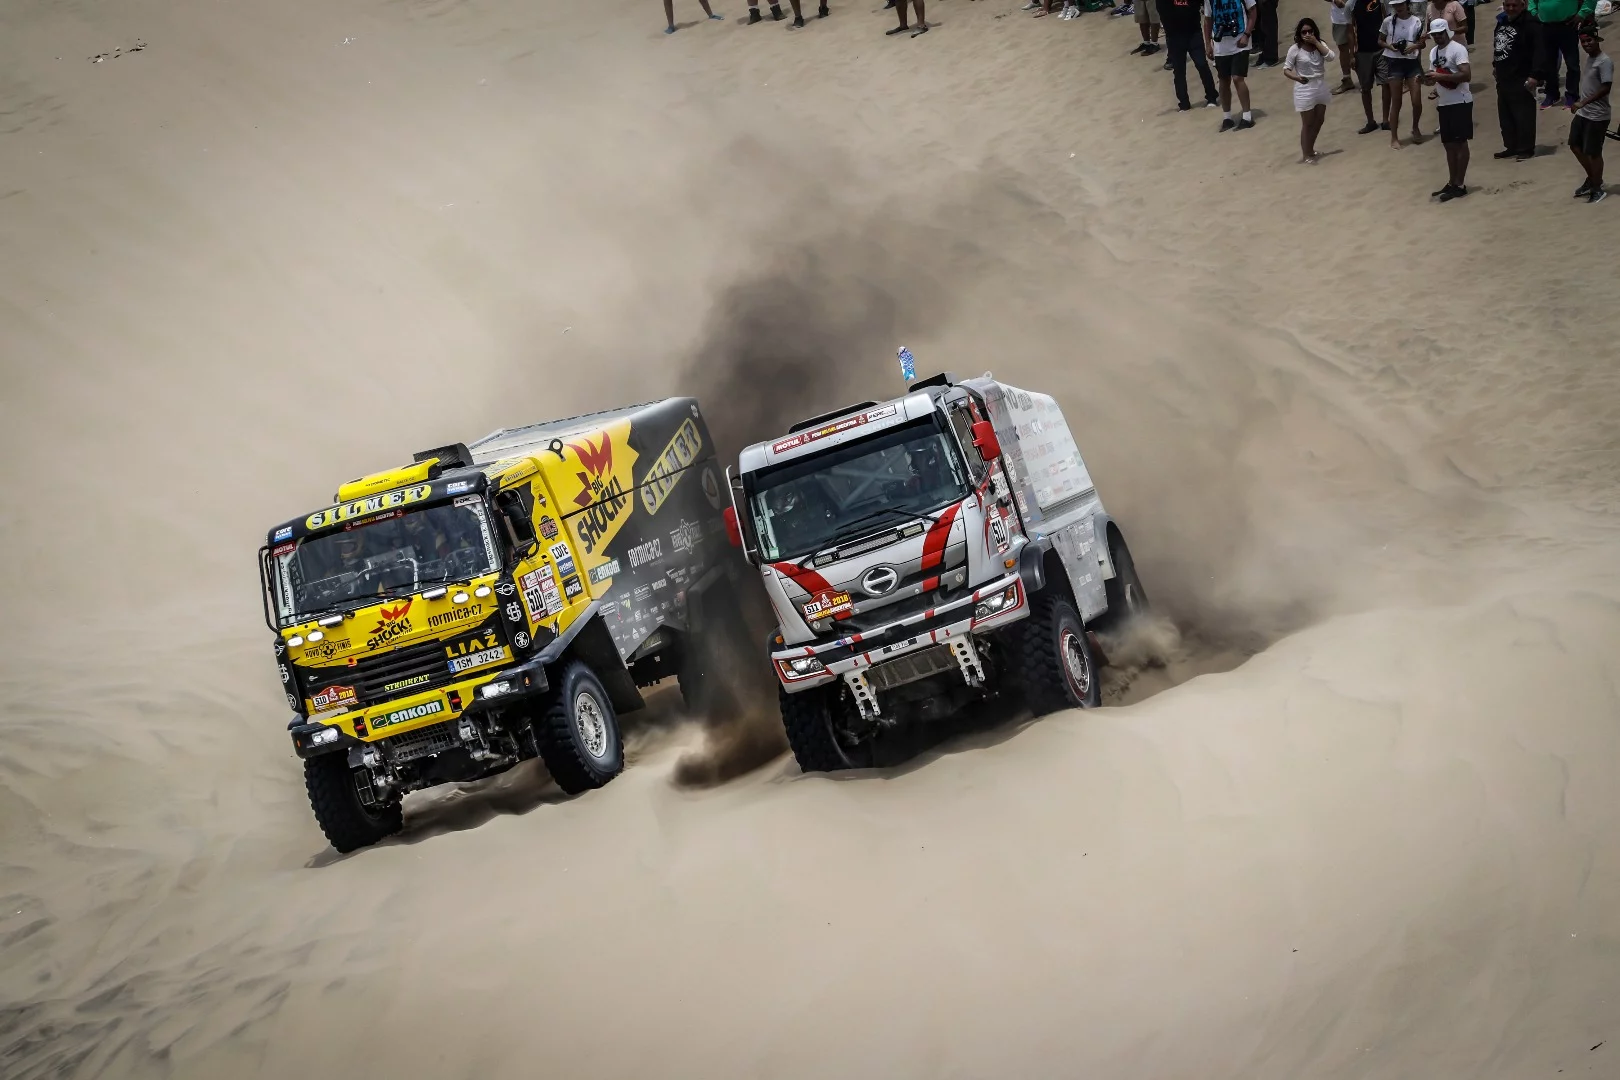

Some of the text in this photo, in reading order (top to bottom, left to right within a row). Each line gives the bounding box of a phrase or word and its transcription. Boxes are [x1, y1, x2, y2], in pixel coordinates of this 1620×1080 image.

[776, 438, 800, 452] MOTUL
[644, 421, 699, 508] SILMET
[591, 475, 603, 495] BIG
[312, 486, 424, 527] SILMET
[577, 475, 627, 554] SHOCK!
[276, 527, 292, 535] core
[992, 519, 1006, 545] 511
[274, 544, 294, 554] MOTUL
[551, 543, 569, 560] core
[526, 588, 544, 613] 510
[806, 604, 820, 614] 511
[832, 594, 849, 605] 2018
[366, 617, 413, 650] SHOCK!
[445, 633, 498, 658] LIAZ
[456, 650, 500, 669] 1SM 3242
[315, 695, 327, 704] 510
[339, 690, 354, 700] 2018
[390, 700, 441, 723] enkom
